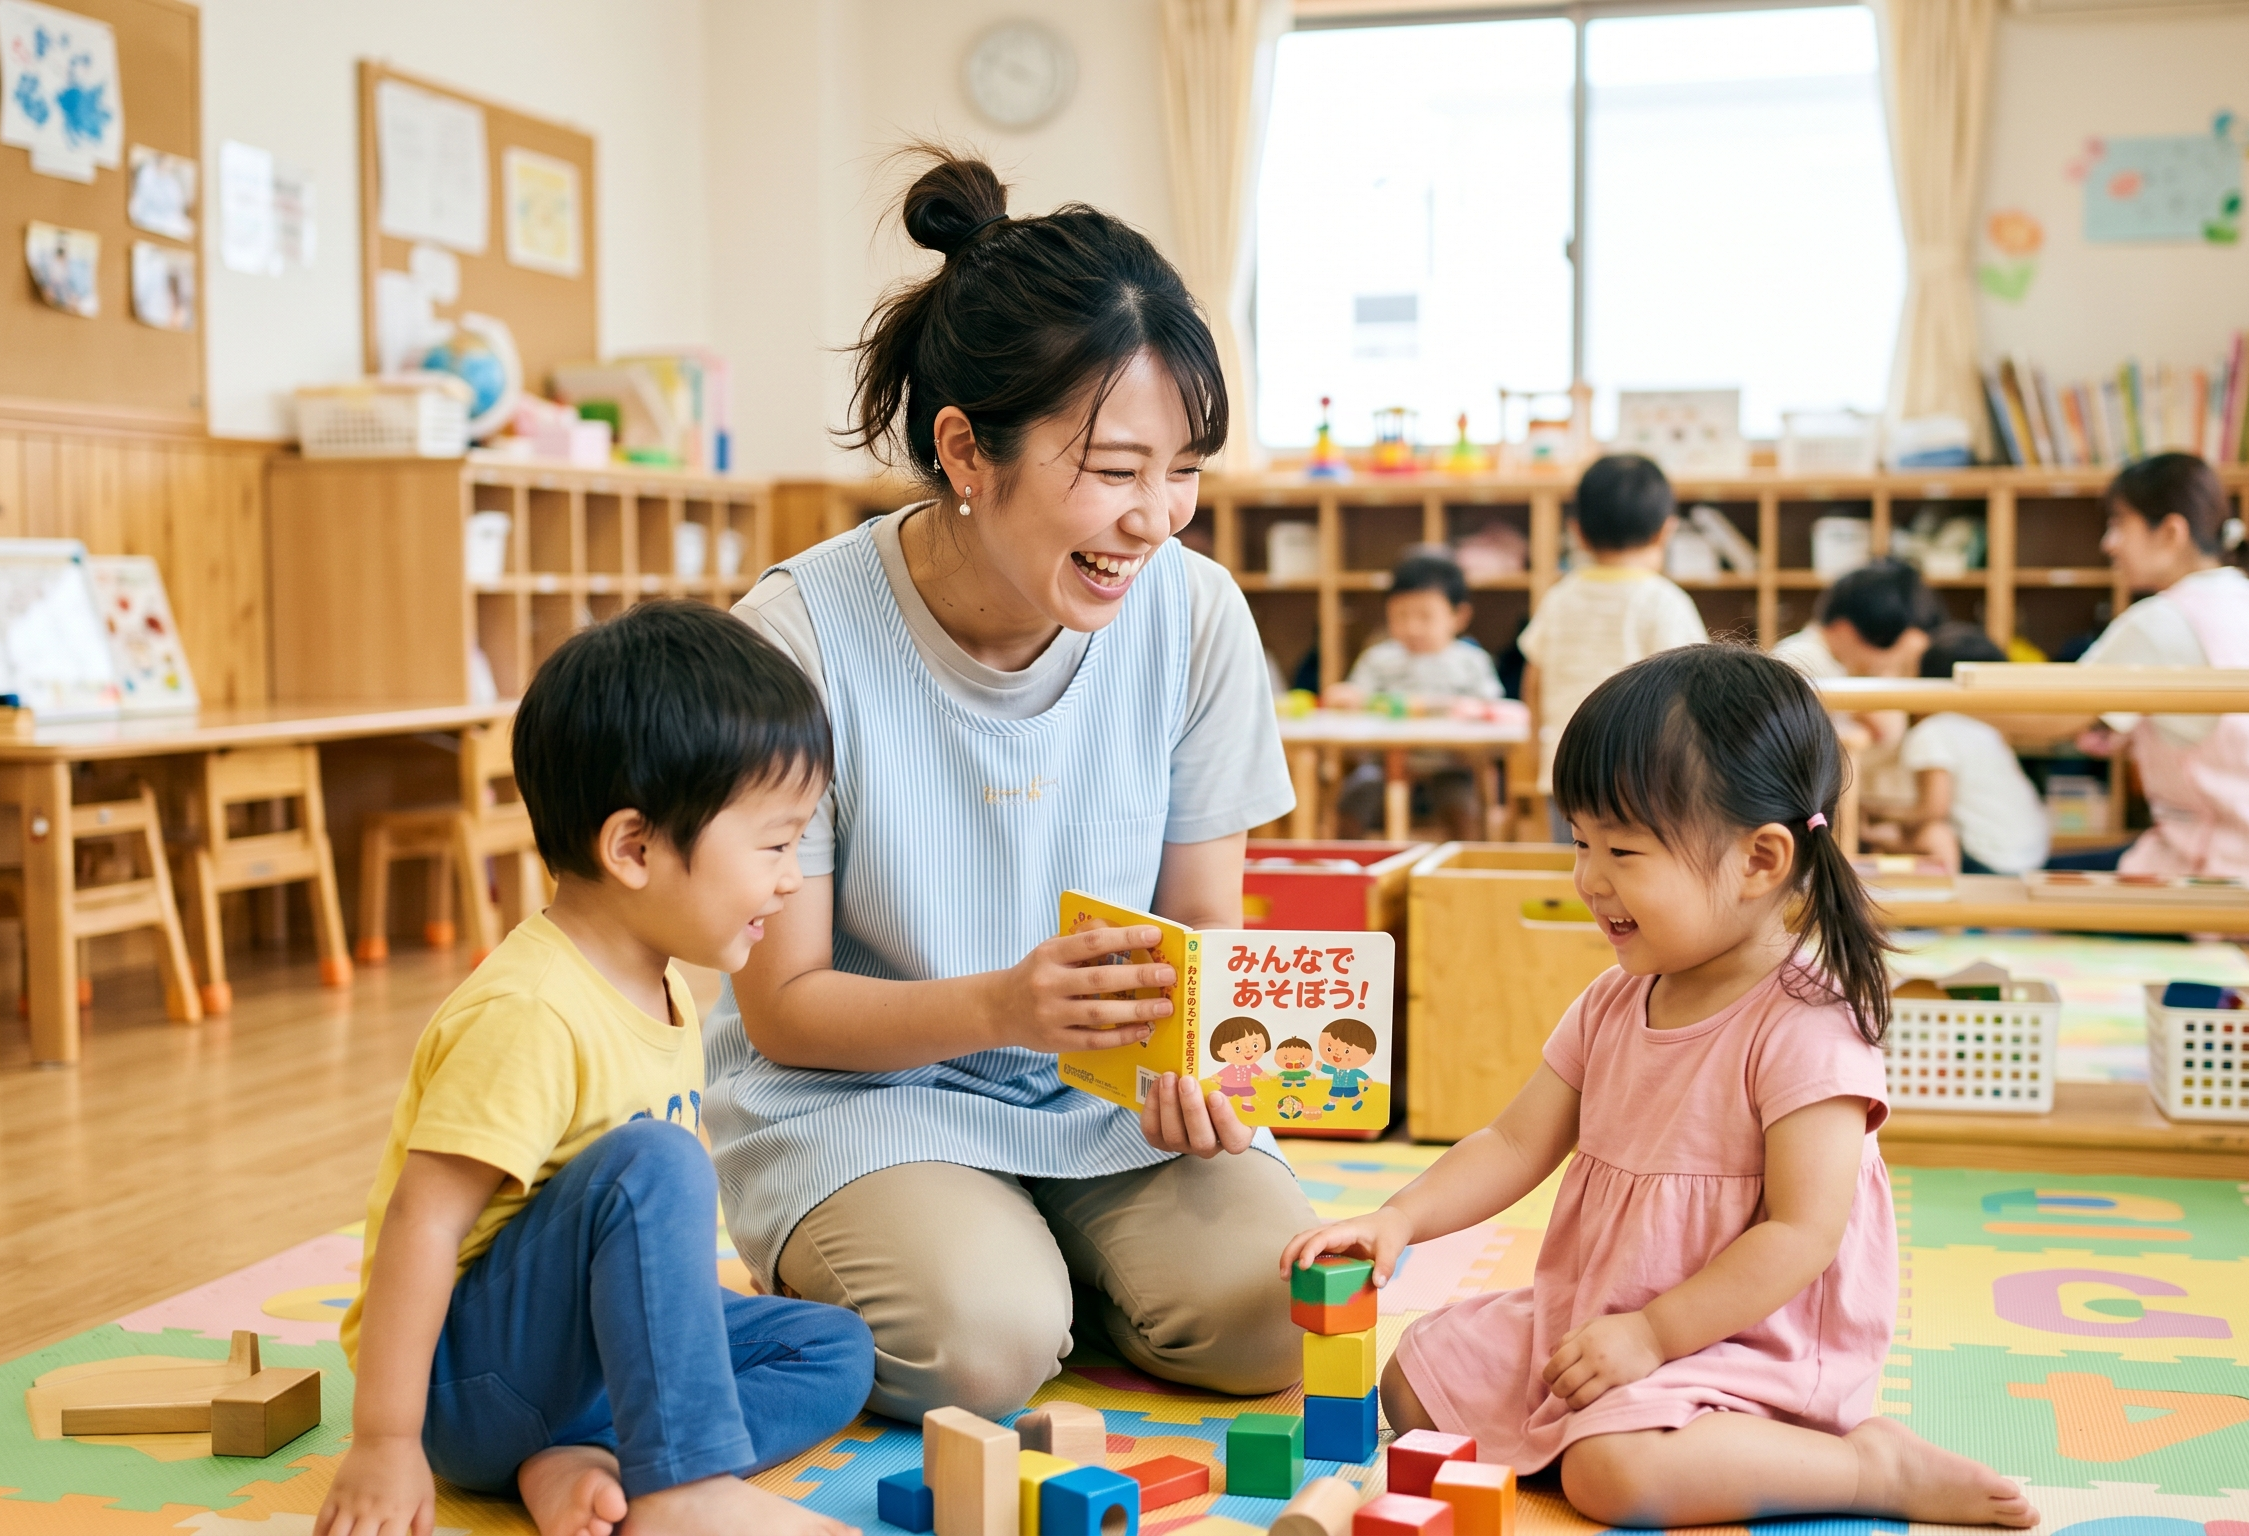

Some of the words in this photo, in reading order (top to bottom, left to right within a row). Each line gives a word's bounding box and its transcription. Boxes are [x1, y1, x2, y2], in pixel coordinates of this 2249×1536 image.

[1227, 945, 1355, 974] みんなで
[1233, 978, 1369, 1010] あそぼう!
